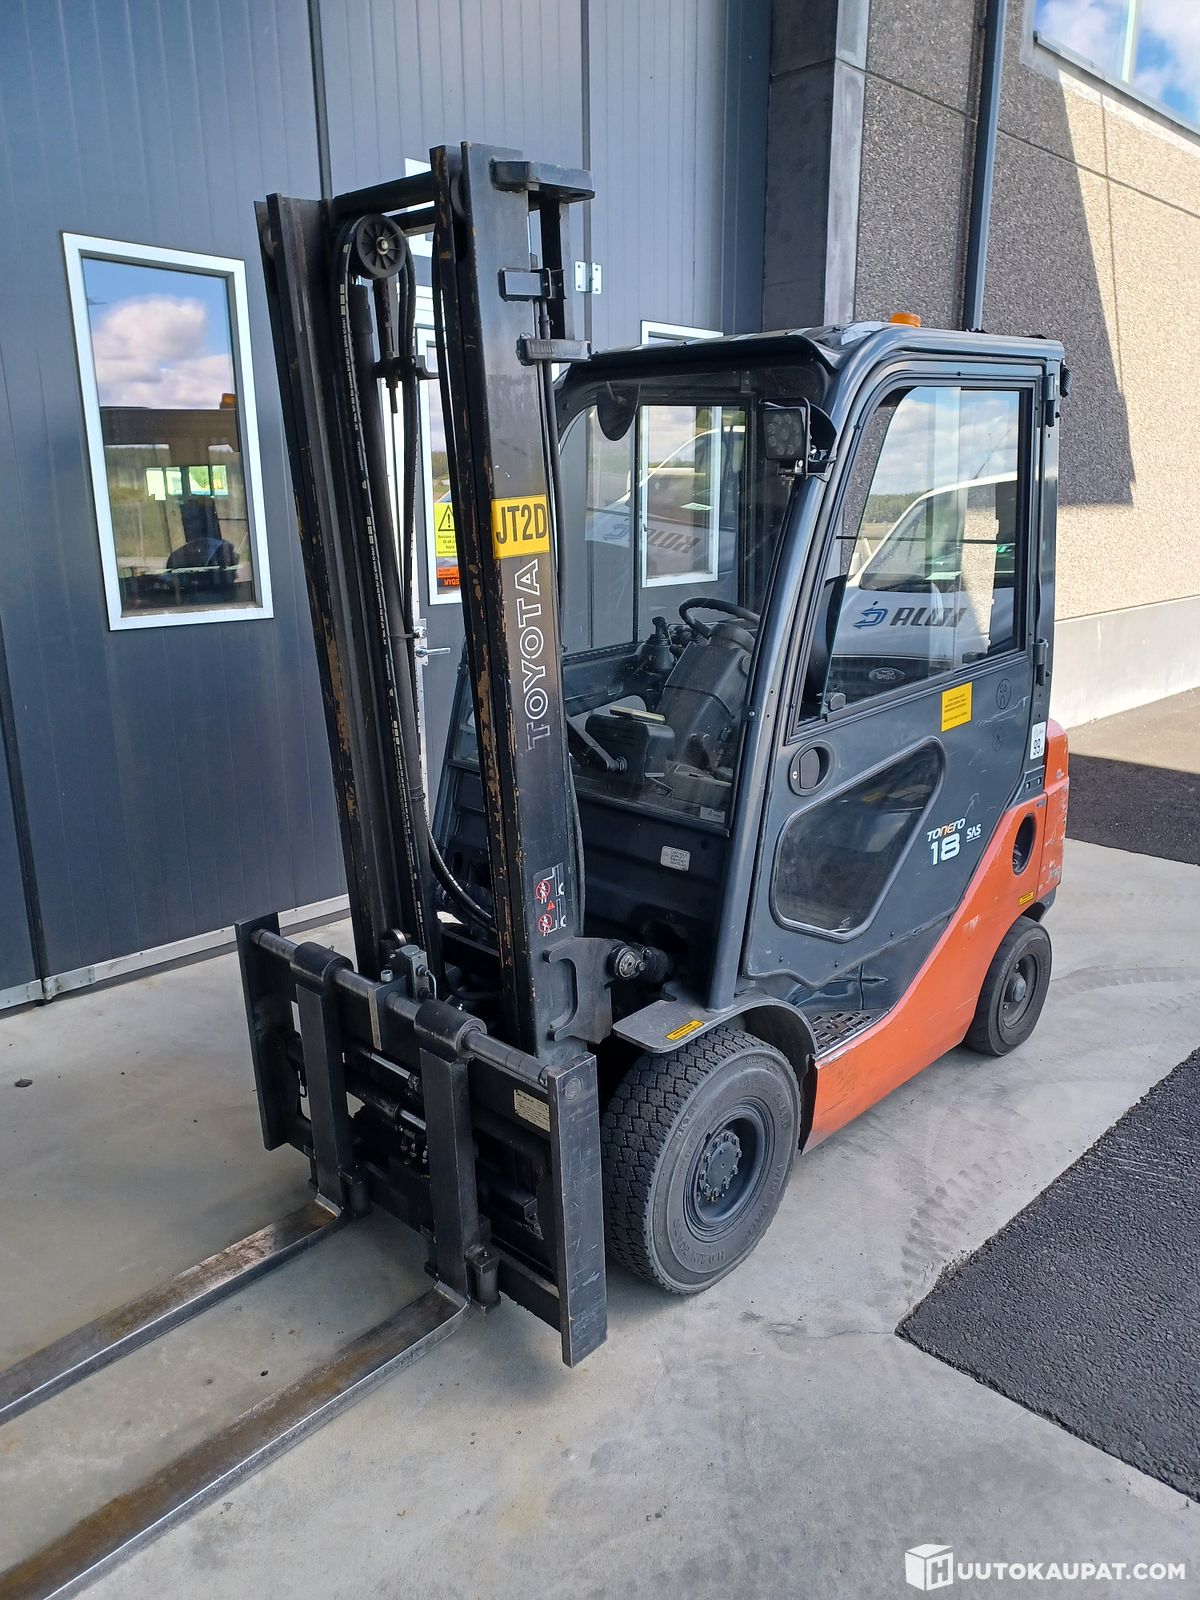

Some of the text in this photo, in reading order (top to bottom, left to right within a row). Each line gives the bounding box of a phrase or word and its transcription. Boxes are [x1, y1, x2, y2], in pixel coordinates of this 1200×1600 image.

[496, 503, 547, 544] JT2D
[514, 558, 550, 751] TOYOTA
[930, 823, 982, 866] 18 SAS
